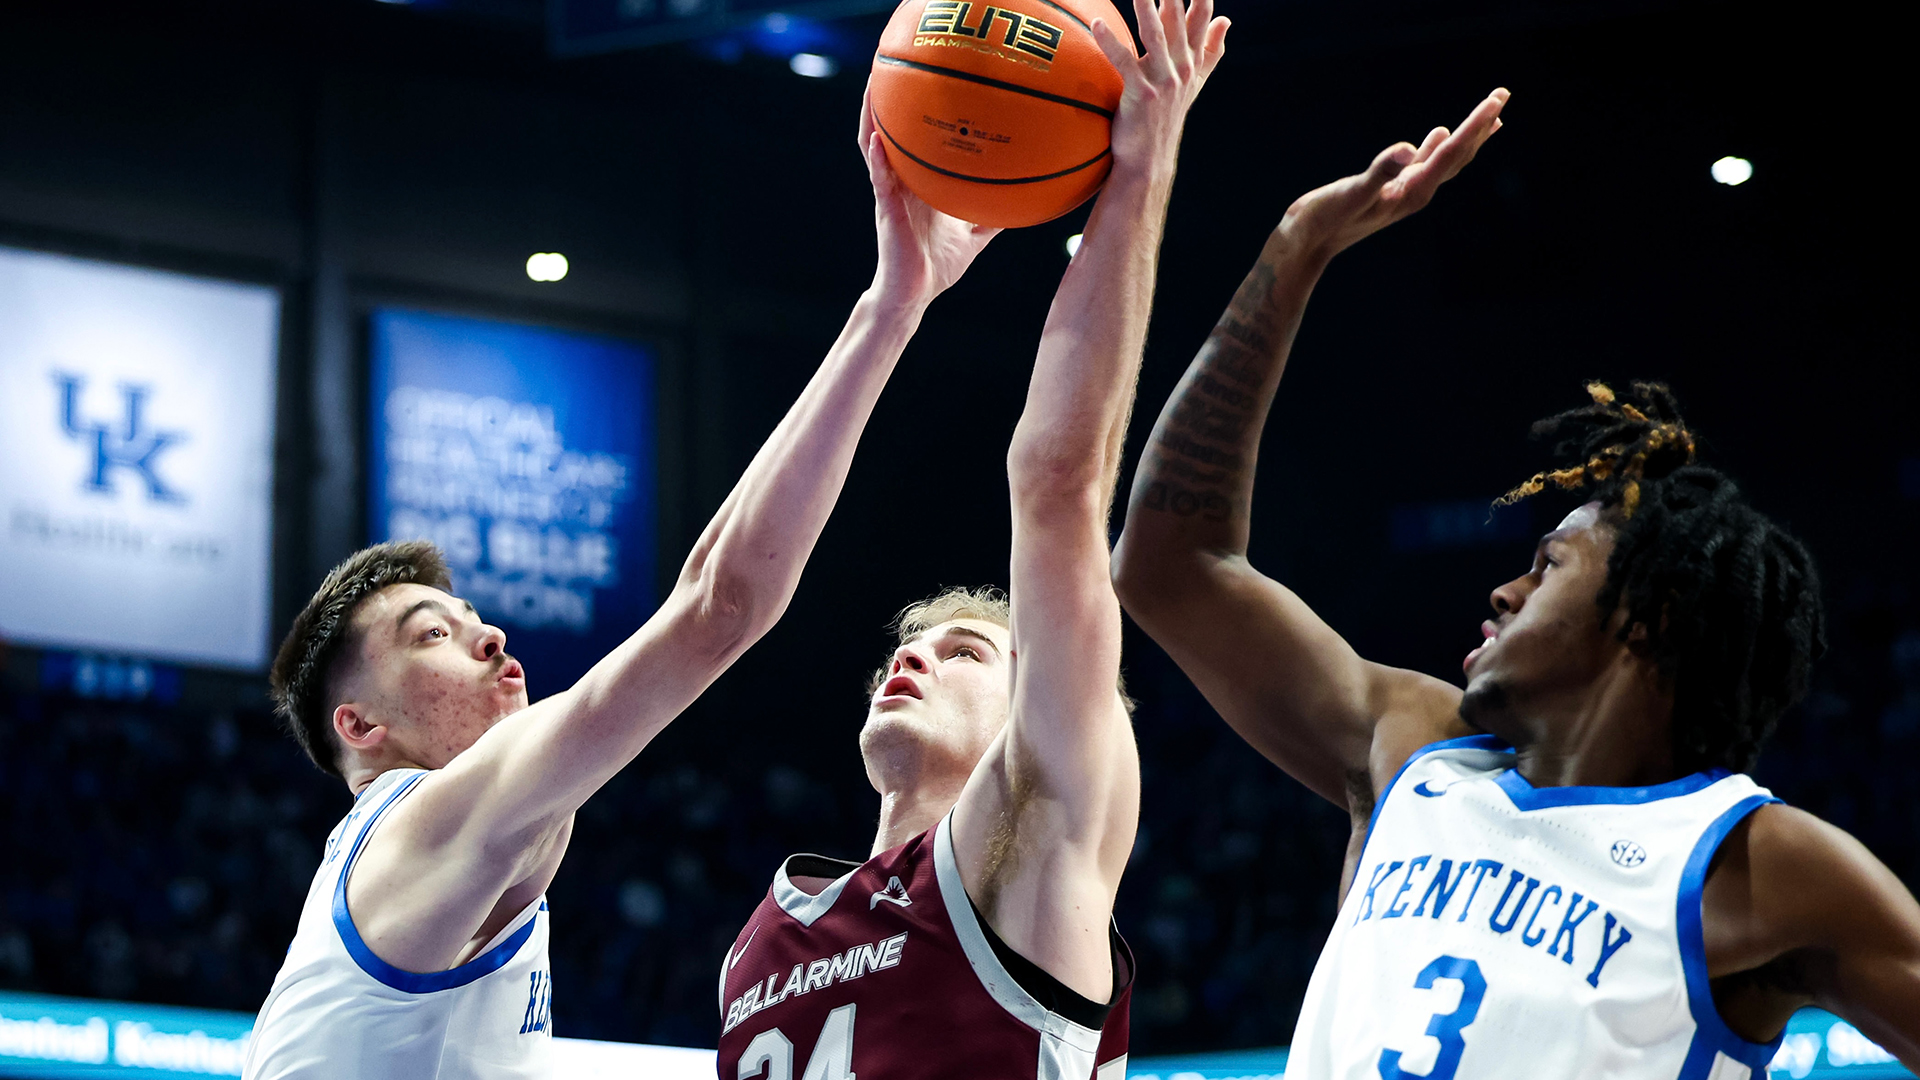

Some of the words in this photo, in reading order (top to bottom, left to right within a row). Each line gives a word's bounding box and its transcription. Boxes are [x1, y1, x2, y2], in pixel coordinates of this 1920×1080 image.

[913, 36, 1050, 73] CHAMPIONSHIP
[47, 367, 192, 508] UK
[722, 931, 908, 1037] BELLARMINE
[1354, 855, 1632, 988] KENTUCKY
[1377, 954, 1488, 1080] 3
